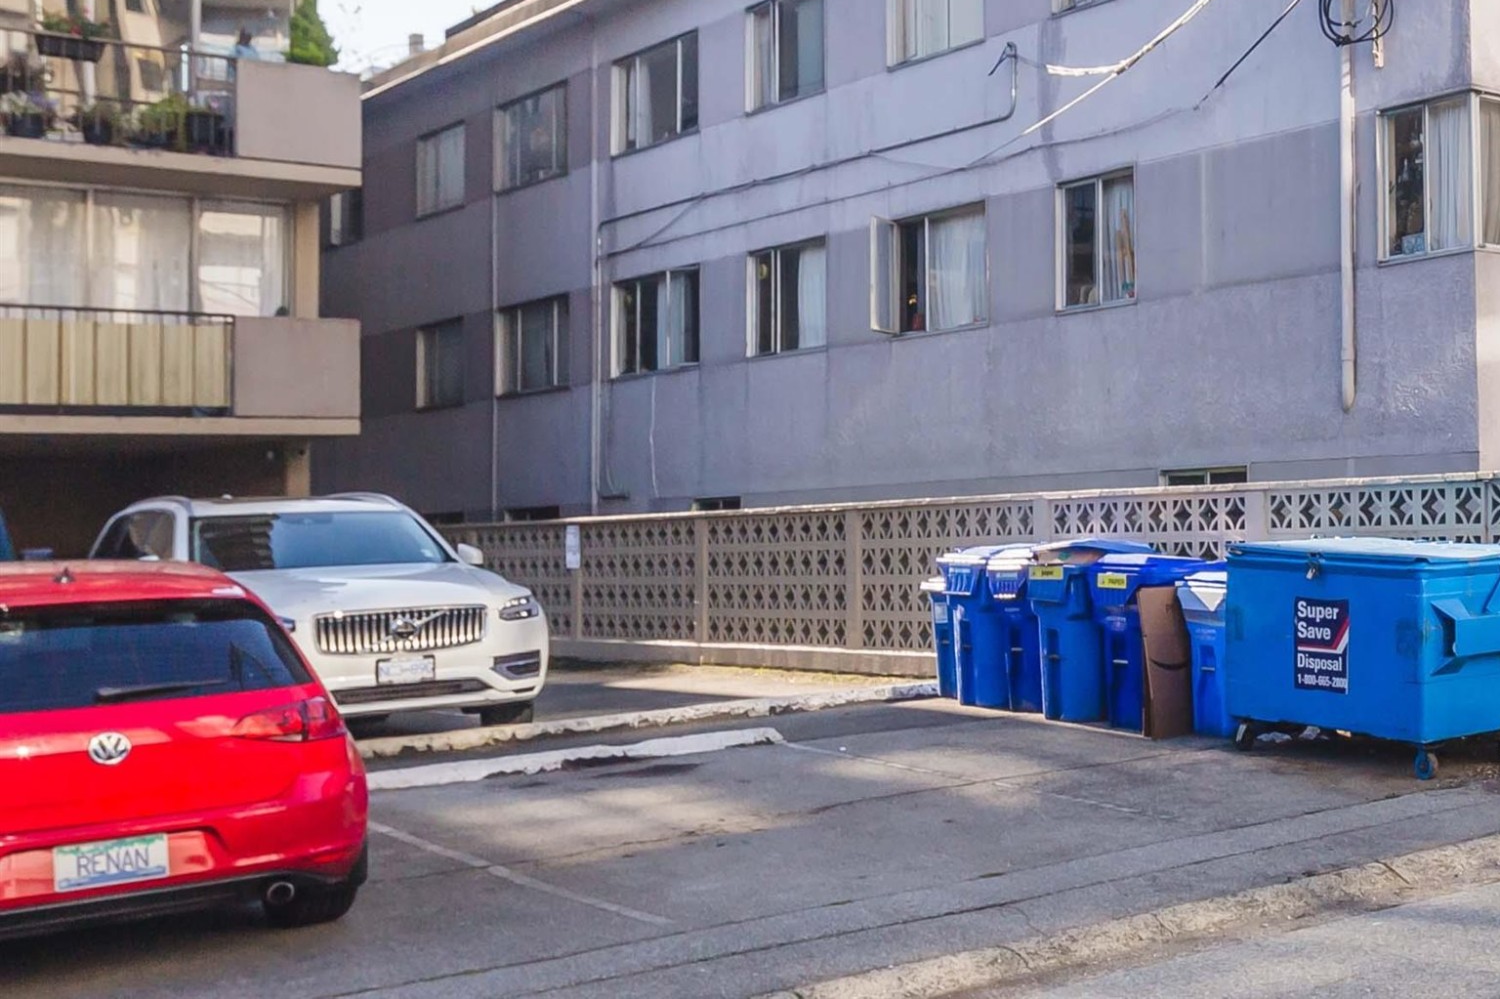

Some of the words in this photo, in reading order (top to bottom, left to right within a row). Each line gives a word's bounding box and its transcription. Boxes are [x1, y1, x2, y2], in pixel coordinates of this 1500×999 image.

[1297, 601, 1340, 623] Super
[1297, 621, 1332, 640] Save
[1297, 652, 1342, 673] Disposal
[76, 846, 150, 878] RENAN
